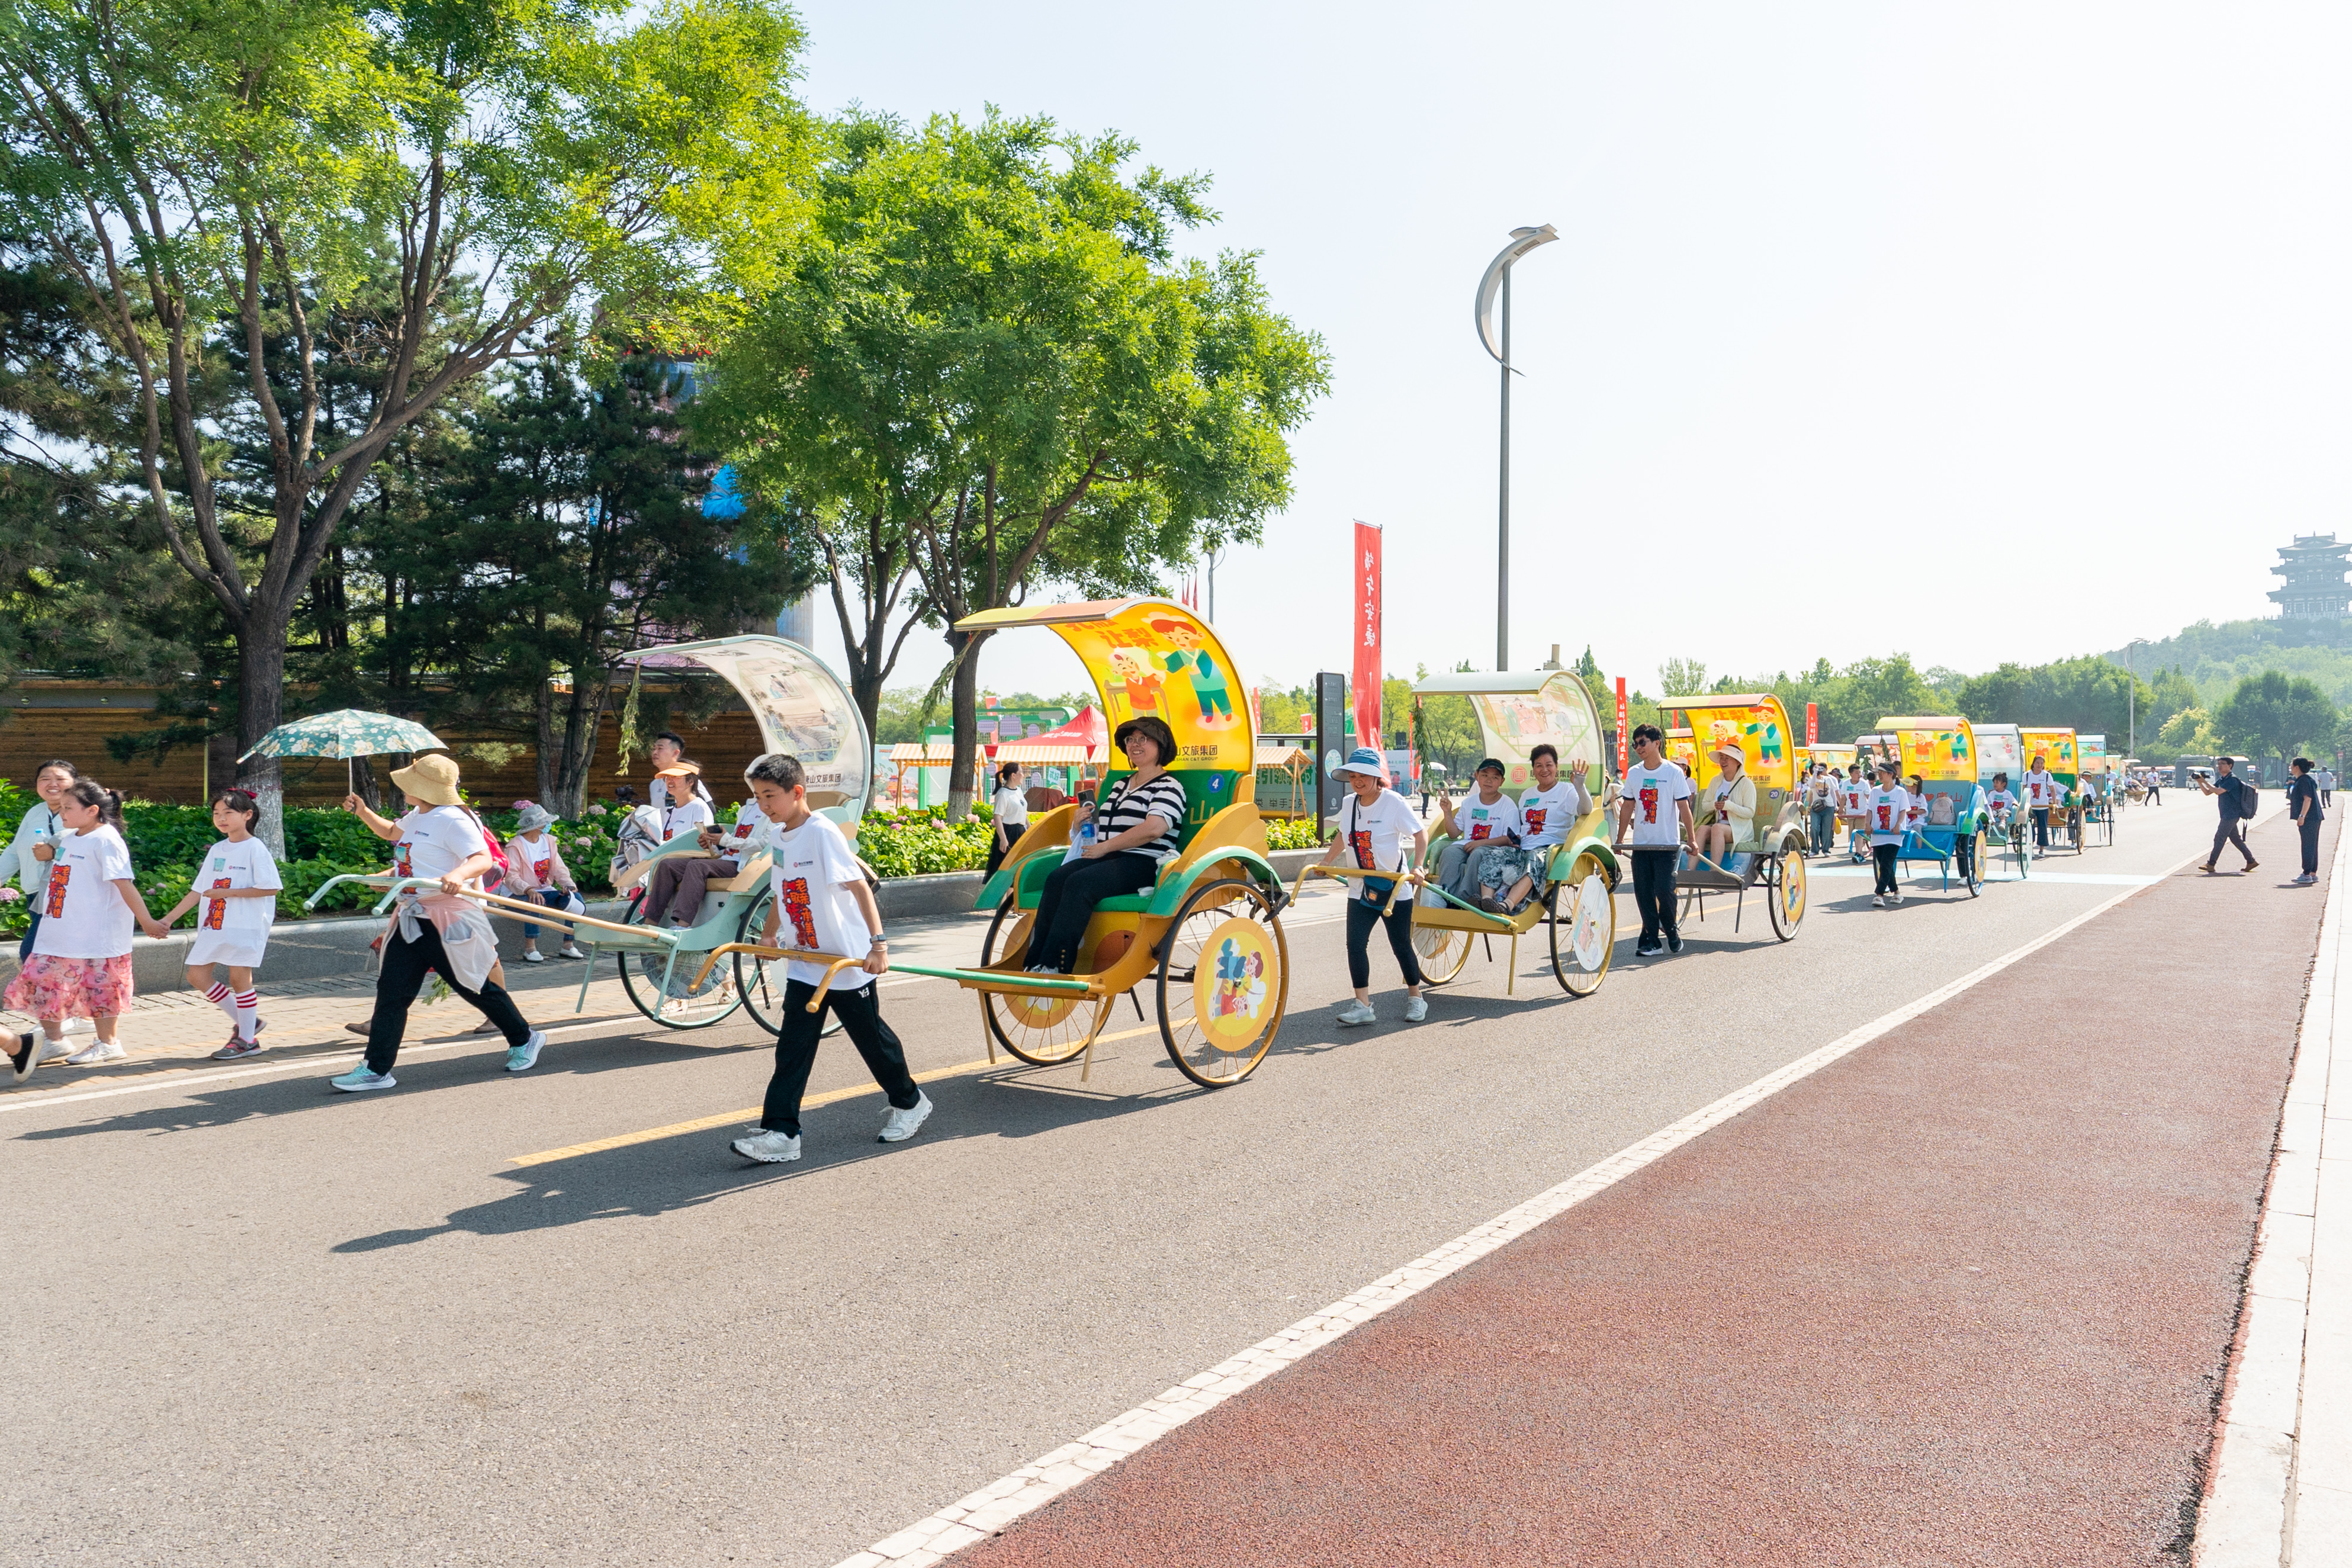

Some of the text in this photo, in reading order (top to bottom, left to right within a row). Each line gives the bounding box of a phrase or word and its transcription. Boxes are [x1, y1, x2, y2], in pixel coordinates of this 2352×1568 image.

[1095, 628, 1159, 648] 让梨
[1711, 709, 1747, 721] 让梨
[1212, 779, 1219, 789] 4
[1190, 800, 1214, 825] 山
[1757, 803, 1773, 816] 山
